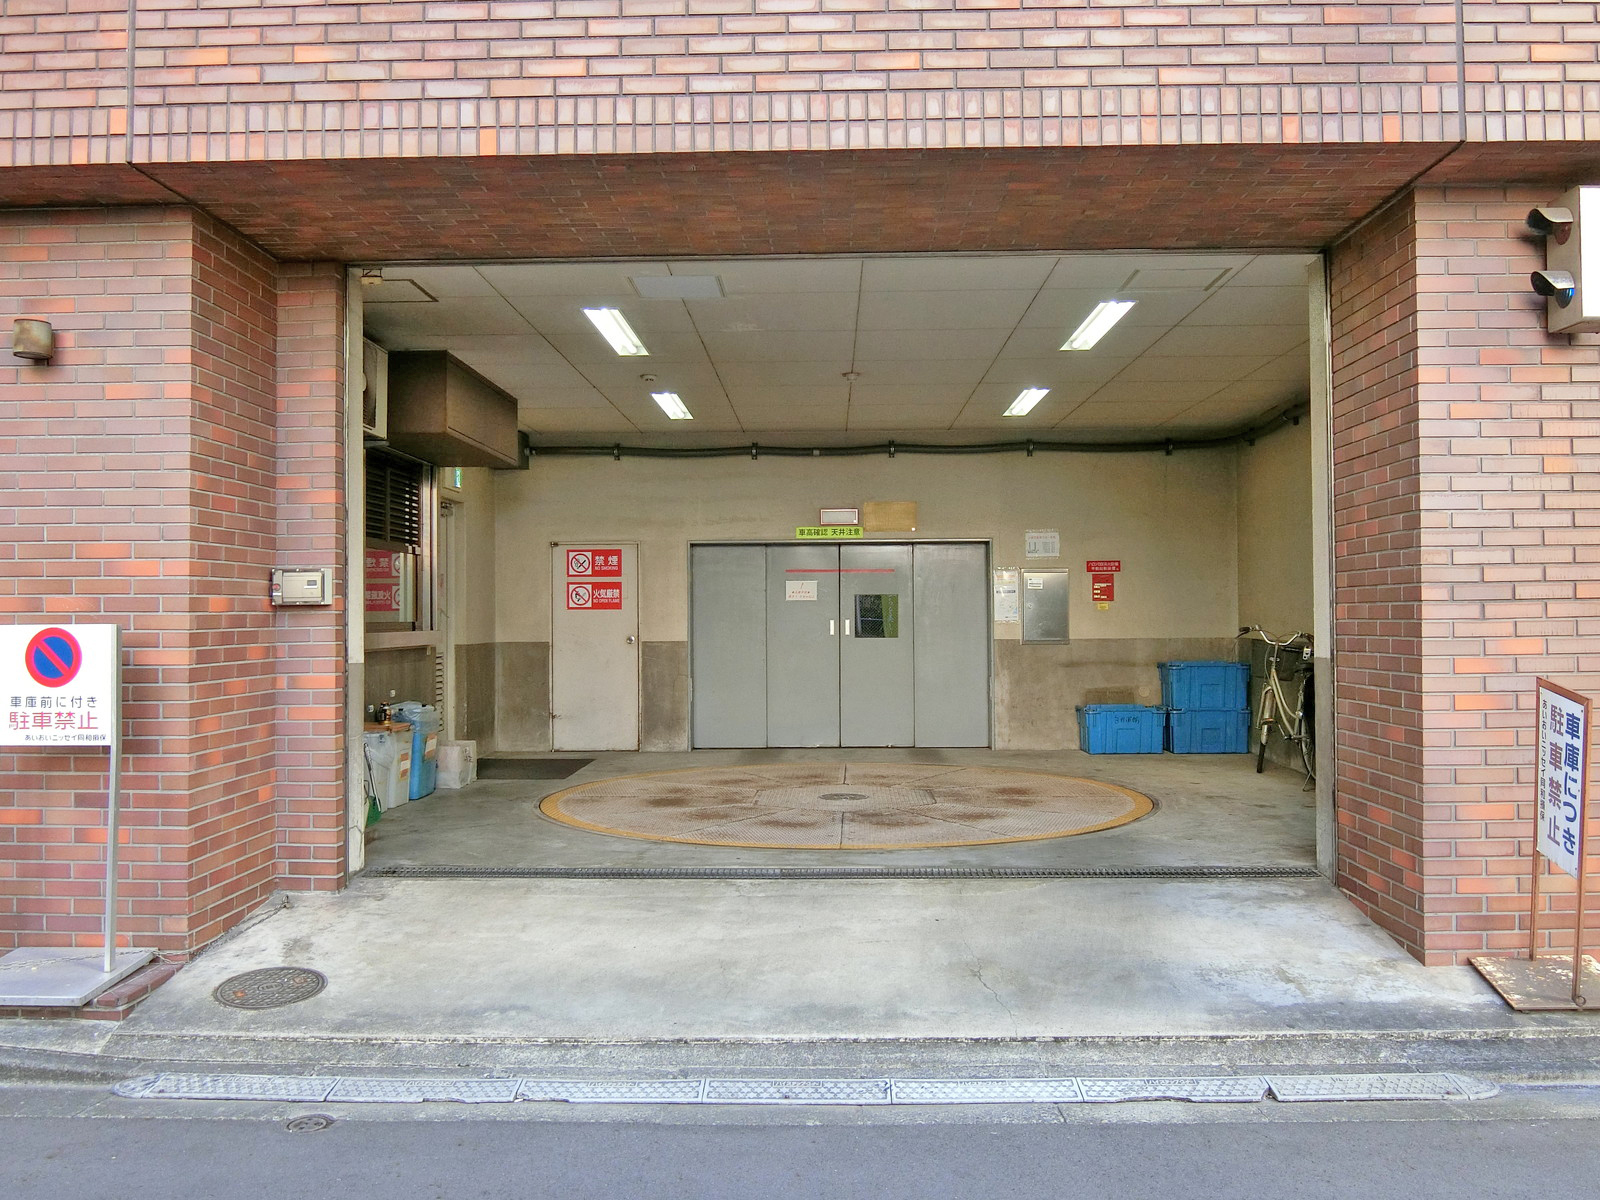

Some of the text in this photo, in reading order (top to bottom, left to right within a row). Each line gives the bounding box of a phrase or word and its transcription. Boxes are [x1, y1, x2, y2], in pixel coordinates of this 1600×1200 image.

[798, 528, 860, 536] 車高確認 天井注意
[594, 555, 619, 566] 禁煙
[593, 589, 620, 598] 火気厳禁
[10, 696, 97, 708] 車庫前に付き
[9, 711, 99, 730] 駐車禁止
[1547, 704, 1564, 847] 駐車禁止
[1562, 712, 1581, 856] 車庫につき
